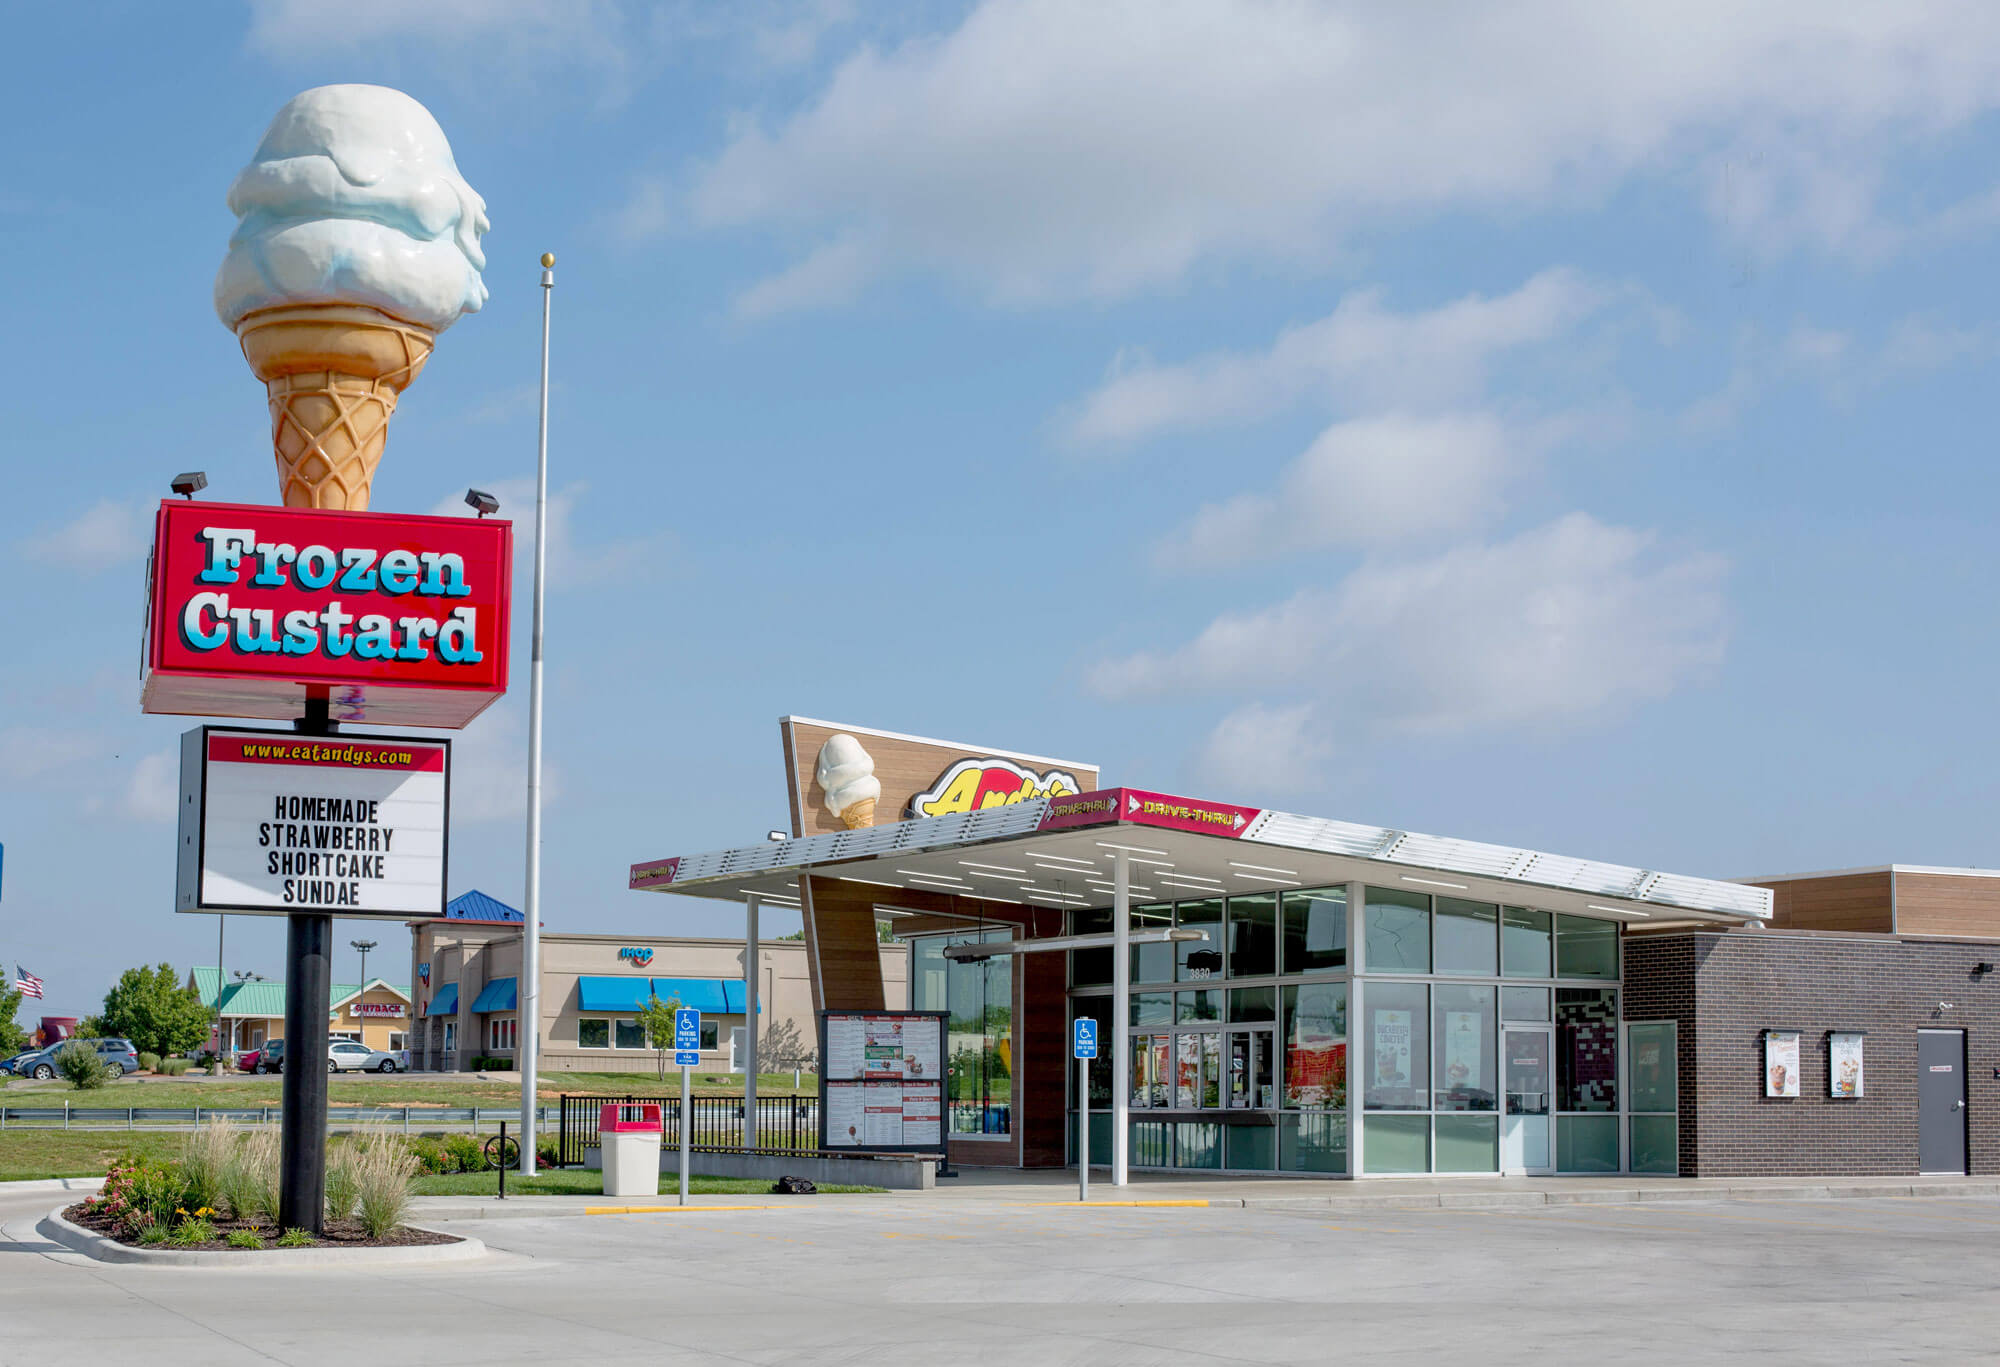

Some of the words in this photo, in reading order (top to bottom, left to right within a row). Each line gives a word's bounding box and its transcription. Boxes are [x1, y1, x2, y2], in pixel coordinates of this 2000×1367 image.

[198, 527, 471, 596] Frozen
[181, 592, 483, 664] Custard
[241, 743, 412, 765] www.eatandys.com
[275, 796, 378, 823] HOMEMADE
[1143, 801, 1234, 825] DRIVE-THRU
[259, 823, 393, 851] STRAWBERRY
[268, 851, 384, 878] SHORTCAKE
[283, 879, 360, 905] SUNDAE
[1190, 967, 1210, 979] 3830
[354, 1003, 401, 1013] OUTBACK
